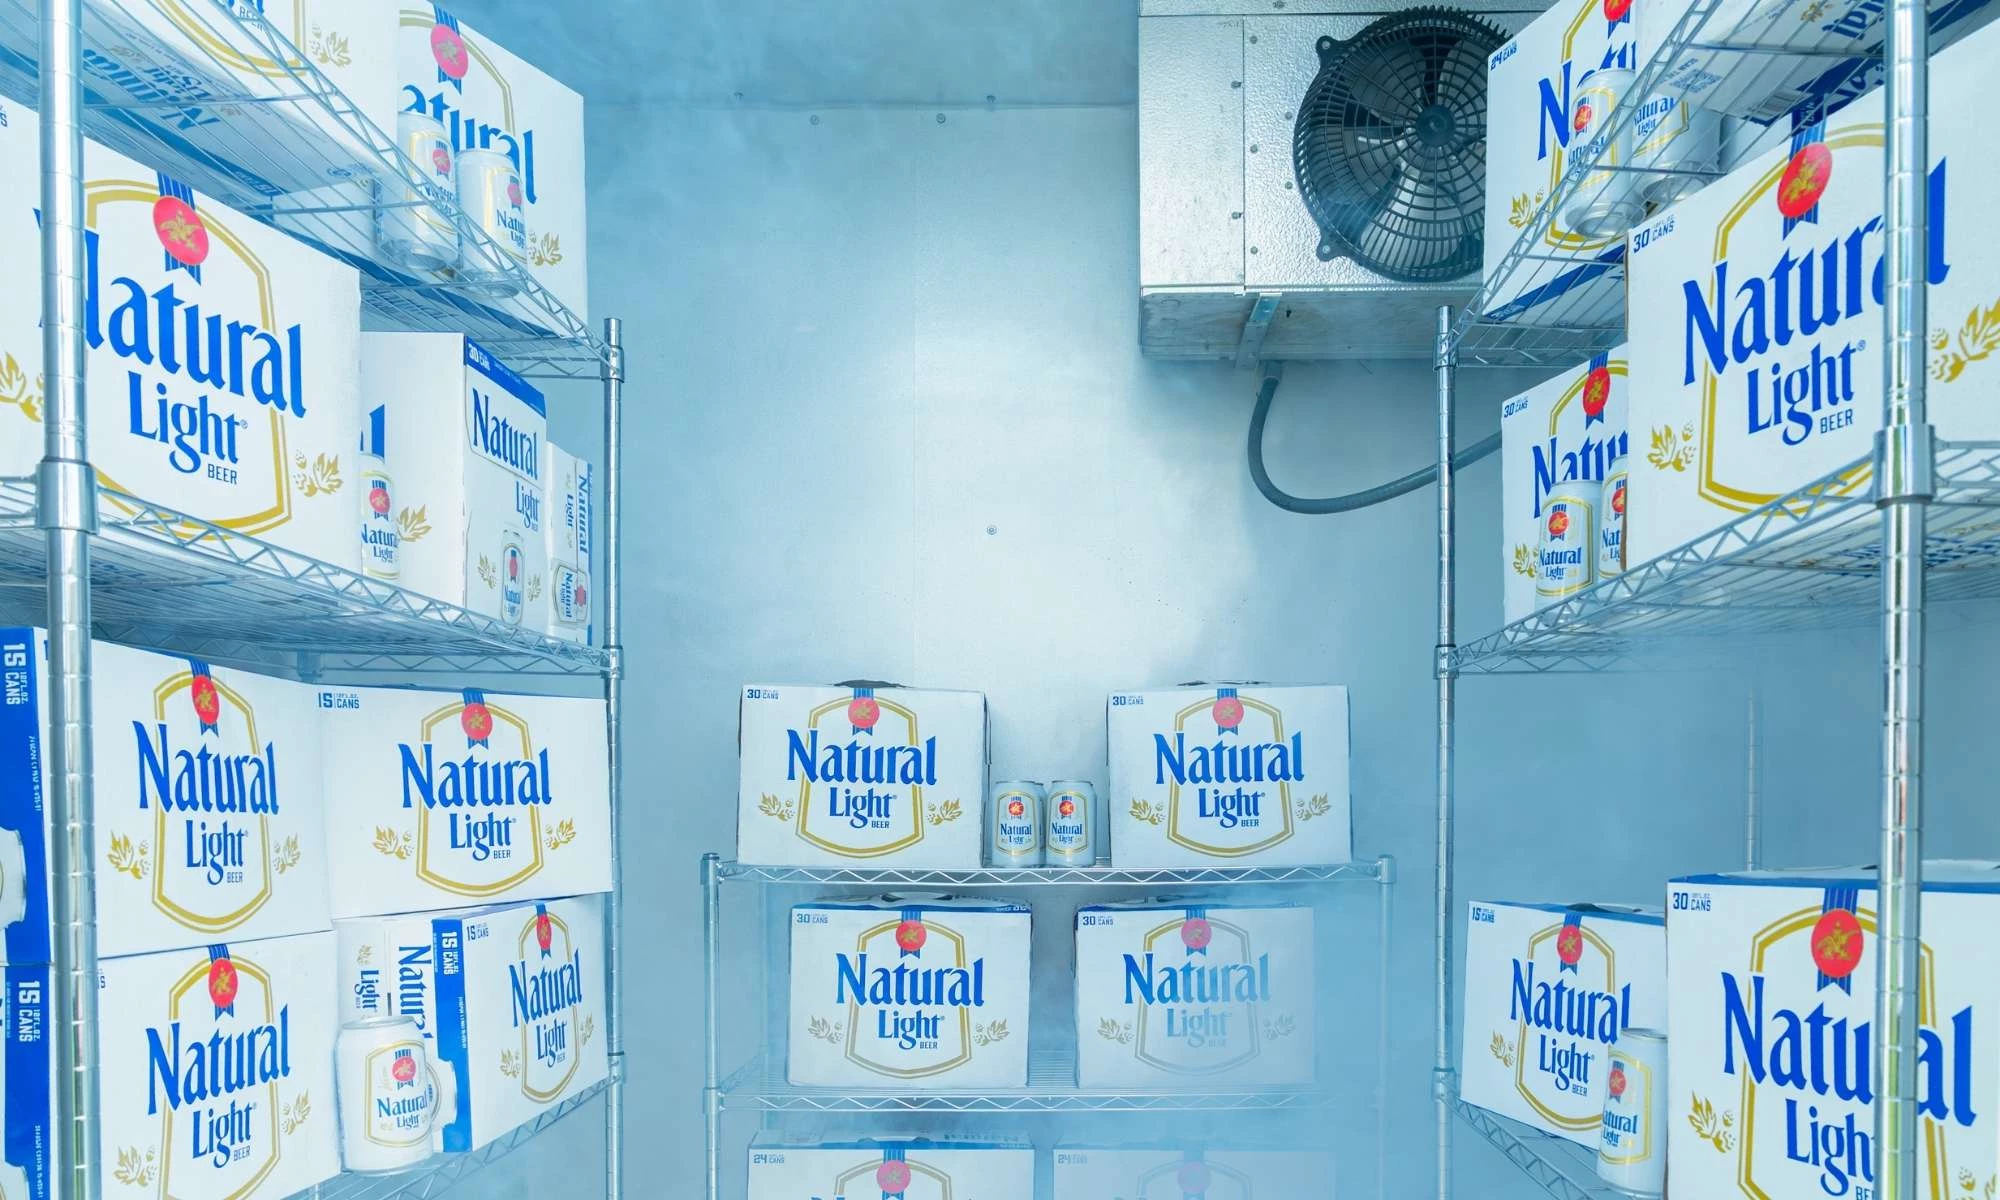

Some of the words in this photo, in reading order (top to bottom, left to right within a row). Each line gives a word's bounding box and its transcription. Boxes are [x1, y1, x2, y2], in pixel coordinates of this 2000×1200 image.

[1633, 228, 1650, 253] 30
[1652, 223, 1674, 241] CANS
[1682, 156, 1951, 386] Naturl
[1504, 405, 1514, 418] 30
[1747, 343, 1856, 446] Light
[128, 370, 240, 474] Light
[472, 387, 537, 480] Natural
[1820, 408, 1853, 434] BEER
[207, 463, 237, 485] BEER
[515, 481, 541, 530] Light
[565, 494, 574, 527] Light
[578, 475, 588, 553] Natural
[4, 643, 26, 667] 15
[5, 672, 21, 705] CANS
[318, 692, 332, 708] 15
[336, 699, 360, 709] CANS
[747, 689, 760, 699] 30
[1112, 696, 1126, 706] 30
[132, 720, 279, 815] Natural
[787, 729, 937, 786] Natural
[1152, 731, 1305, 786] Natural
[398, 743, 552, 810] Natural
[829, 787, 892, 829] Light
[871, 820, 890, 829] BEER
[1198, 787, 1262, 829] Light
[1241, 819, 1260, 828] BEER
[449, 811, 512, 862] Light
[1000, 823, 1032, 835] Natural
[1051, 821, 1082, 835] Natural
[185, 820, 244, 886] Light
[493, 850, 511, 859] BEER
[227, 871, 243, 883] BEER
[796, 913, 810, 923] 30
[1673, 892, 1688, 910] 30
[1691, 899, 1711, 912] CANS
[1082, 916, 1096, 926] 30
[441, 931, 458, 949] 15
[18, 980, 41, 1004] 15
[354, 970, 380, 1009] Light
[509, 948, 582, 1027] Natural
[836, 953, 984, 1007] Natural
[1123, 952, 1271, 1005] Natural
[1510, 958, 1631, 1045] Natural
[19, 1009, 33, 1043] CANS
[536, 1017, 567, 1068] Light
[878, 1009, 942, 1050] Light
[1167, 1007, 1230, 1048] Light
[145, 1003, 290, 1116] Natural
[919, 1041, 938, 1049] BEER
[1721, 971, 1977, 1127] Natual
[1539, 1034, 1591, 1091] Light
[377, 1089, 428, 1118] Natural
[1571, 1083, 1588, 1097] BEER
[192, 1100, 252, 1168] Light
[396, 1114, 420, 1130] Light
[233, 1145, 251, 1162] BEER
[753, 1154, 767, 1164] 24
[1785, 1098, 1874, 1197] Ligh
